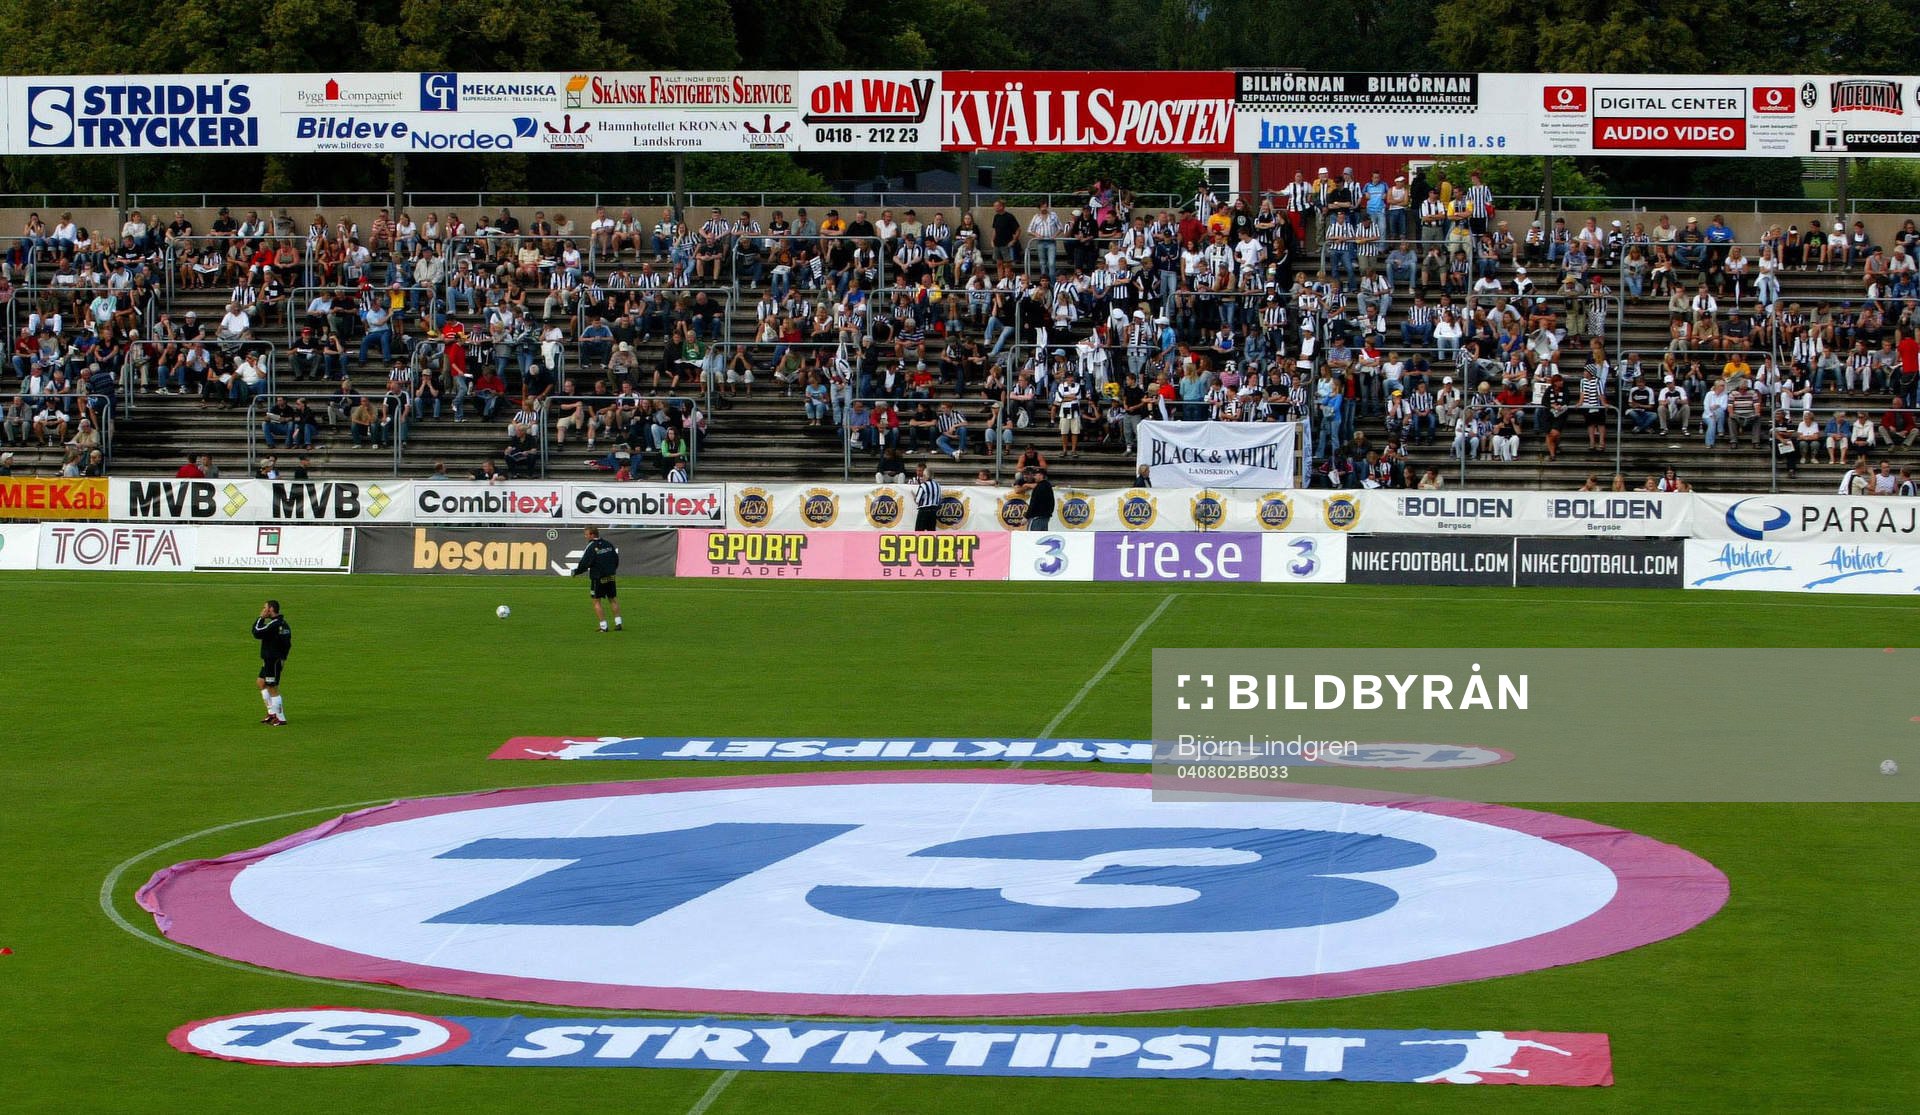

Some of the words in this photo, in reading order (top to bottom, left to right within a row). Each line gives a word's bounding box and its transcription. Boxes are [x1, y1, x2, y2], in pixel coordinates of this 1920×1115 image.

[463, 84, 556, 96] MEKANISKA
[1242, 73, 1344, 92] BILHÖRNAN
[1368, 74, 1470, 93] BILHÖRNAN
[298, 90, 324, 103] Bygg
[340, 90, 402, 103] Compagniet
[811, 79, 853, 114] ON
[1242, 94, 1304, 102] REPRATIONER
[1416, 94, 1471, 103] BILMÄRKEN
[1601, 98, 1666, 109] DIGITAL
[1672, 98, 1737, 109] CENTER
[1830, 81, 1904, 115] VIDEOMIX
[78, 117, 258, 147] TRYCKERI
[296, 117, 408, 139] Bildeve
[599, 121, 674, 131] Hamnhotellet
[680, 121, 738, 131] KRONAN
[816, 128, 852, 142] 0418
[869, 128, 895, 142] 212
[899, 128, 918, 142] 23
[1261, 116, 1357, 142] Invest
[1604, 126, 1668, 140] AUDIO
[1674, 126, 1735, 140] VIDEO
[317, 141, 384, 150] www.bildeve.se
[411, 129, 513, 149] Nordea
[543, 134, 593, 143] KRONAN
[633, 136, 702, 146] Landskrona
[742, 134, 793, 143] KRONAN
[1386, 134, 1506, 148] www.inla.se
[1151, 438, 1205, 466] BLACK
[1209, 450, 1221, 463] &
[1226, 443, 1278, 470] WHITE
[1188, 467, 1239, 476] LANDSKRONA
[129, 481, 216, 517] MVB
[272, 483, 360, 519] MVB
[418, 489, 559, 513] Combitext
[575, 491, 716, 515] Combitext
[1405, 497, 1512, 518] BOLIDEN
[1555, 499, 1662, 519] BOLIDEN
[1801, 506, 1915, 533] PARAJ
[52, 528, 181, 566] TOFTA
[413, 528, 548, 570] besam
[708, 533, 806, 562] SPORT
[878, 535, 980, 565] SPORT
[1117, 535, 1242, 578] tre.se
[1709, 543, 1783, 570] Abitare
[1819, 545, 1891, 570] Abitare
[212, 556, 224, 566] AB
[227, 556, 323, 566] LANDSKRONAHEM
[711, 566, 802, 576] BLADET
[883, 568, 975, 578] BLADET
[420, 822, 1437, 934] 13
[222, 1021, 421, 1051] 13
[507, 1024, 1365, 1073] STRYKTIPSET
